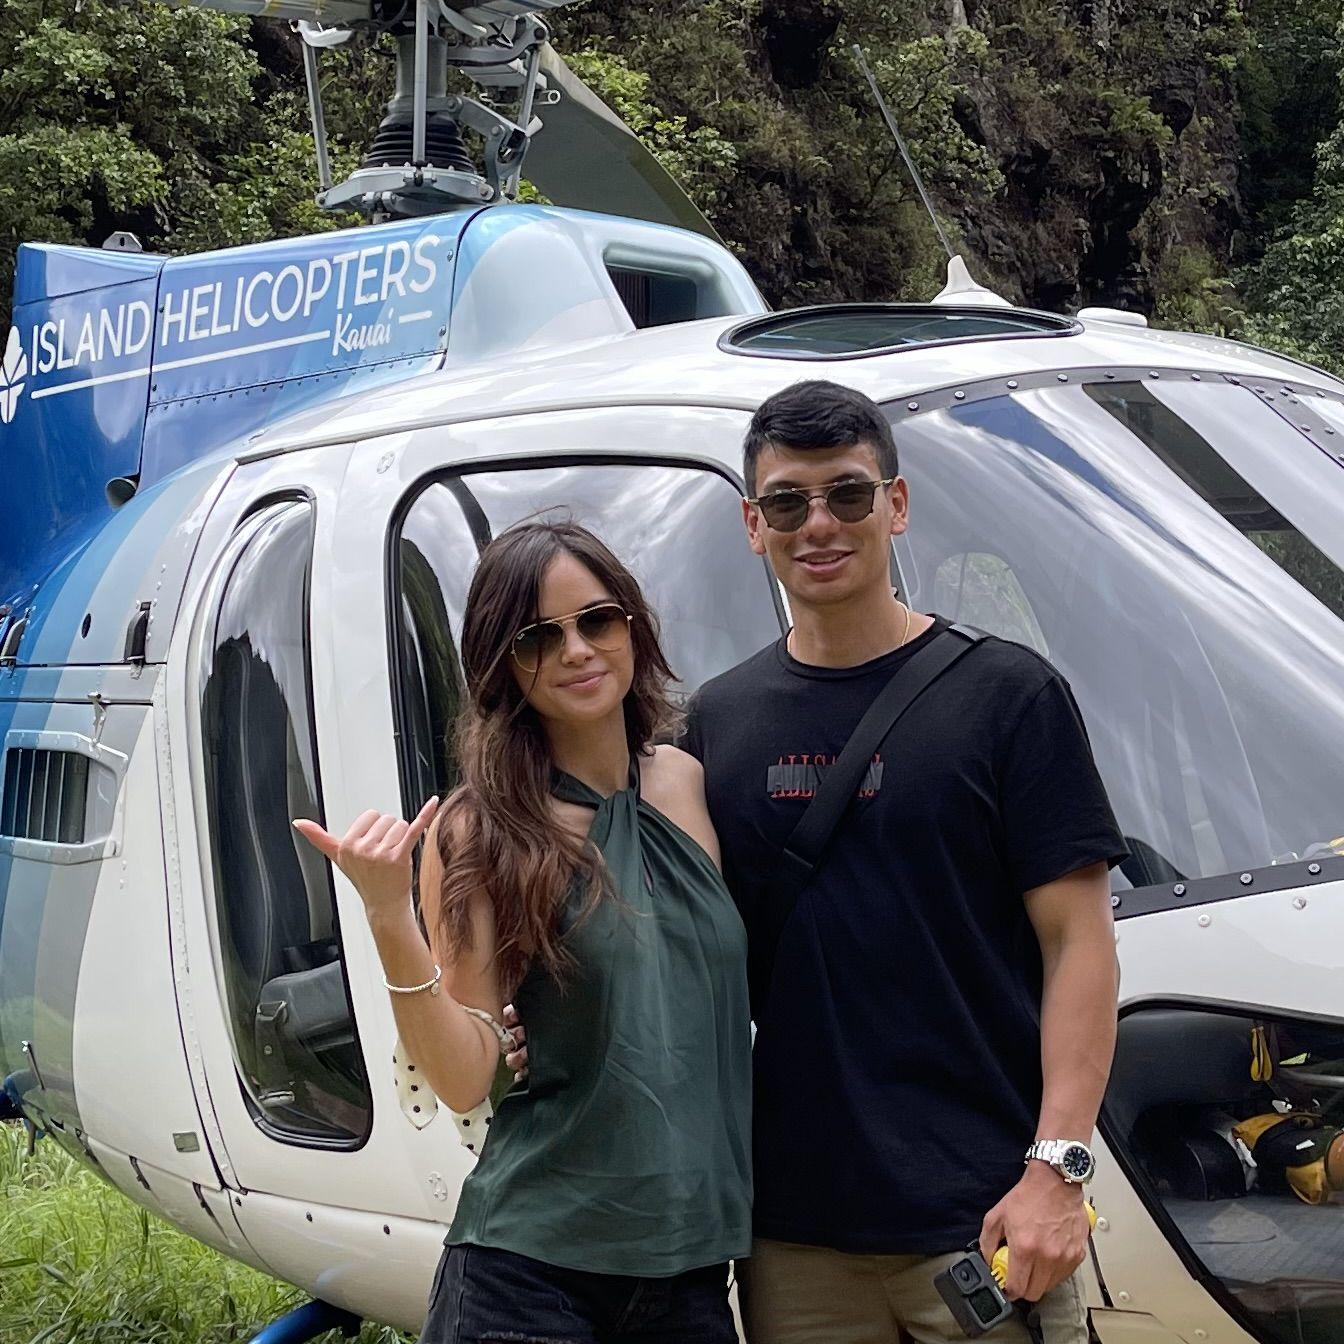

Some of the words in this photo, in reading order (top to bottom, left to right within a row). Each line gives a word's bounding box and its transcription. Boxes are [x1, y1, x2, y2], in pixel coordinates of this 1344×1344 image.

[31, 300, 151, 377] ISLAND
[161, 234, 440, 347] HELICOPTERS
[331, 308, 394, 357] Kauai
